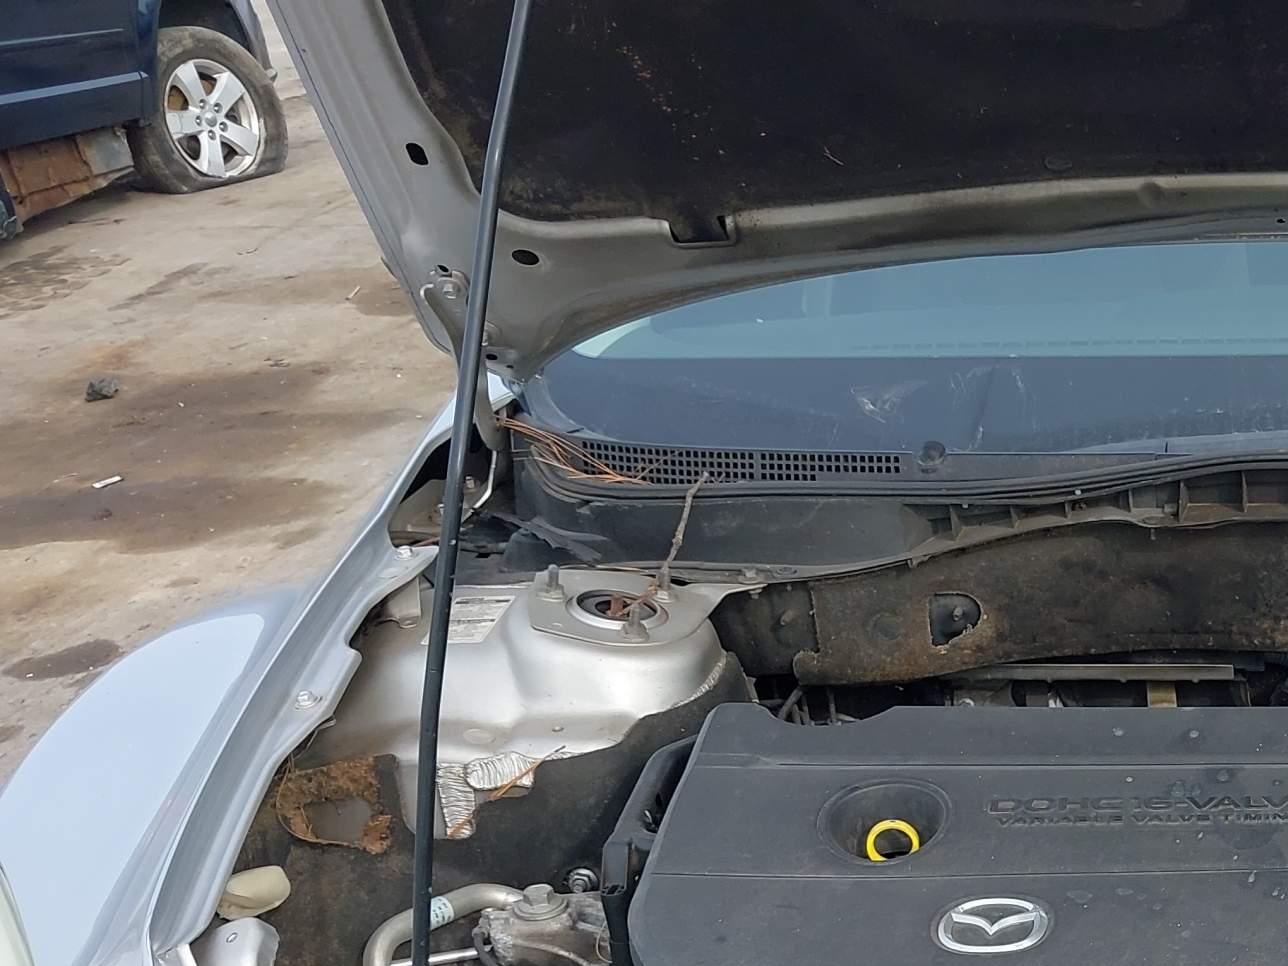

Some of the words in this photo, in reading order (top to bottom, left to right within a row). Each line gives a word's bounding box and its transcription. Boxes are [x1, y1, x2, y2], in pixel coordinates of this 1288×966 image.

[988, 797, 1124, 815] DOHC
[996, 814, 1124, 828] VARIABLE
[1131, 814, 1213, 825] VALVE
